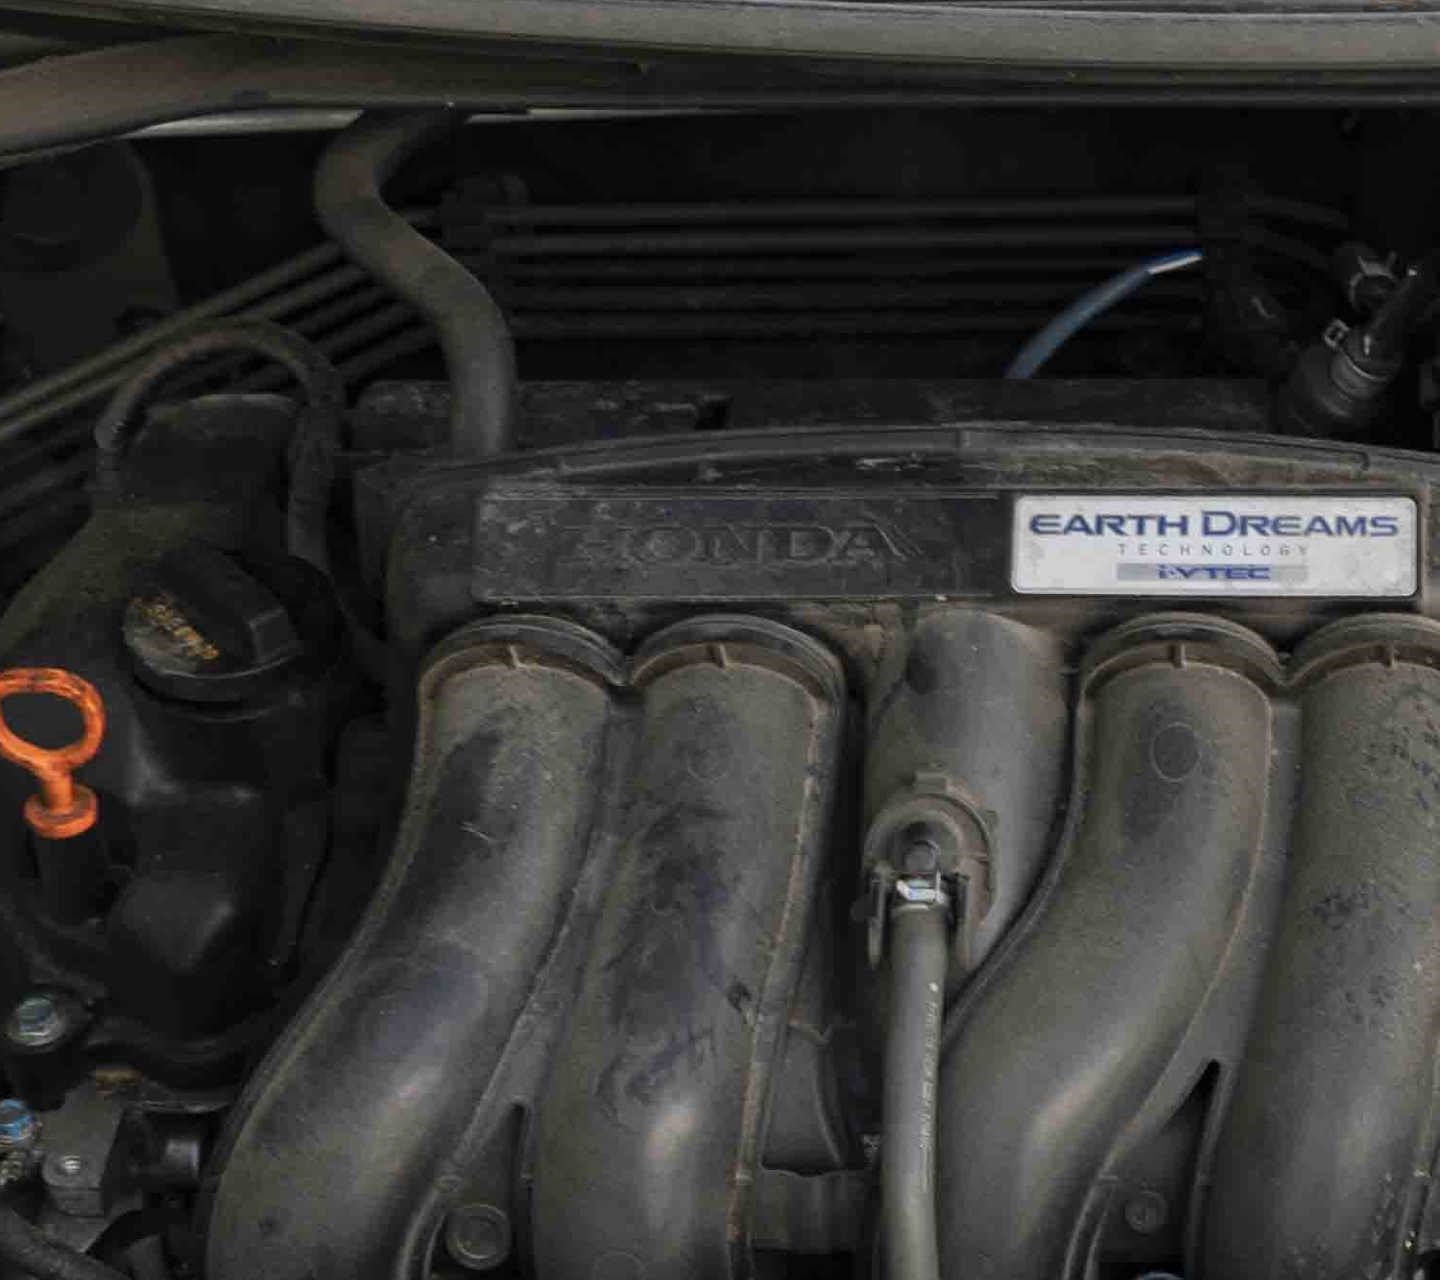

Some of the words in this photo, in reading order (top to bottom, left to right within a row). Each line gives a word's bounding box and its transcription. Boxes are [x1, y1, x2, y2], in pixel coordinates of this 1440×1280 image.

[1028, 513, 1189, 537] EARTH
[1200, 509, 1400, 537] DREAMS
[1116, 542, 1309, 557] TECHNOLOGY
